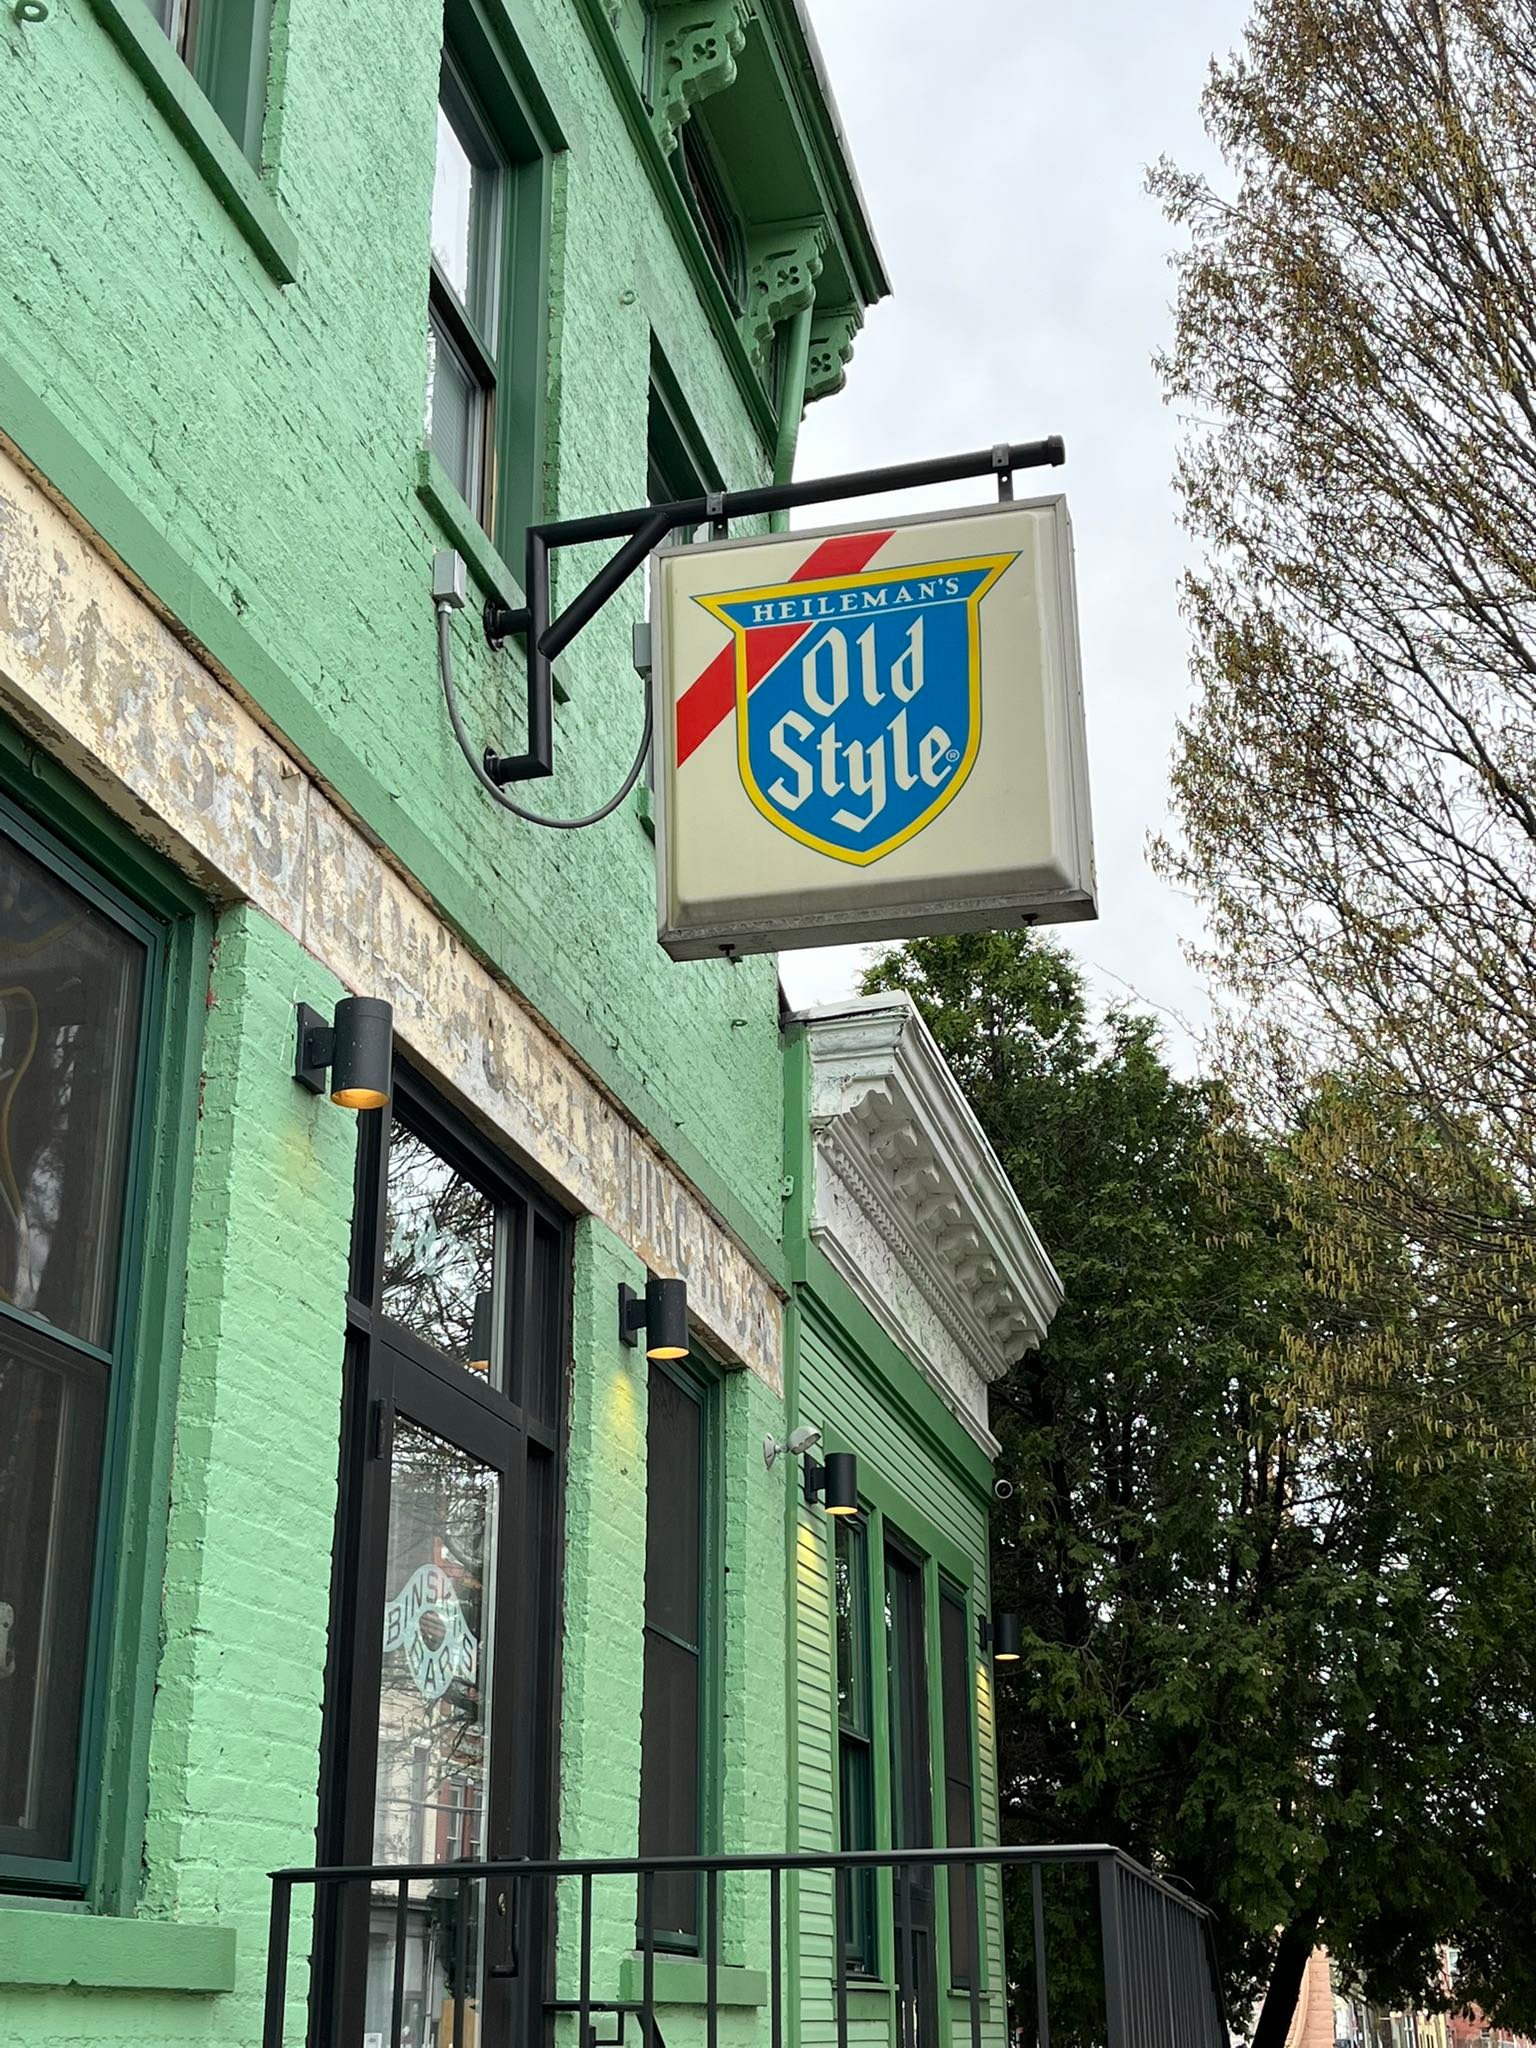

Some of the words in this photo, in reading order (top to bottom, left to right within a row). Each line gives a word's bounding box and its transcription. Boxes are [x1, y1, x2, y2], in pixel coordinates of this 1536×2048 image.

[752, 577, 960, 624] HEILEMAN'S
[802, 614, 924, 717] Old
[408, 1630, 453, 1692] BAR
